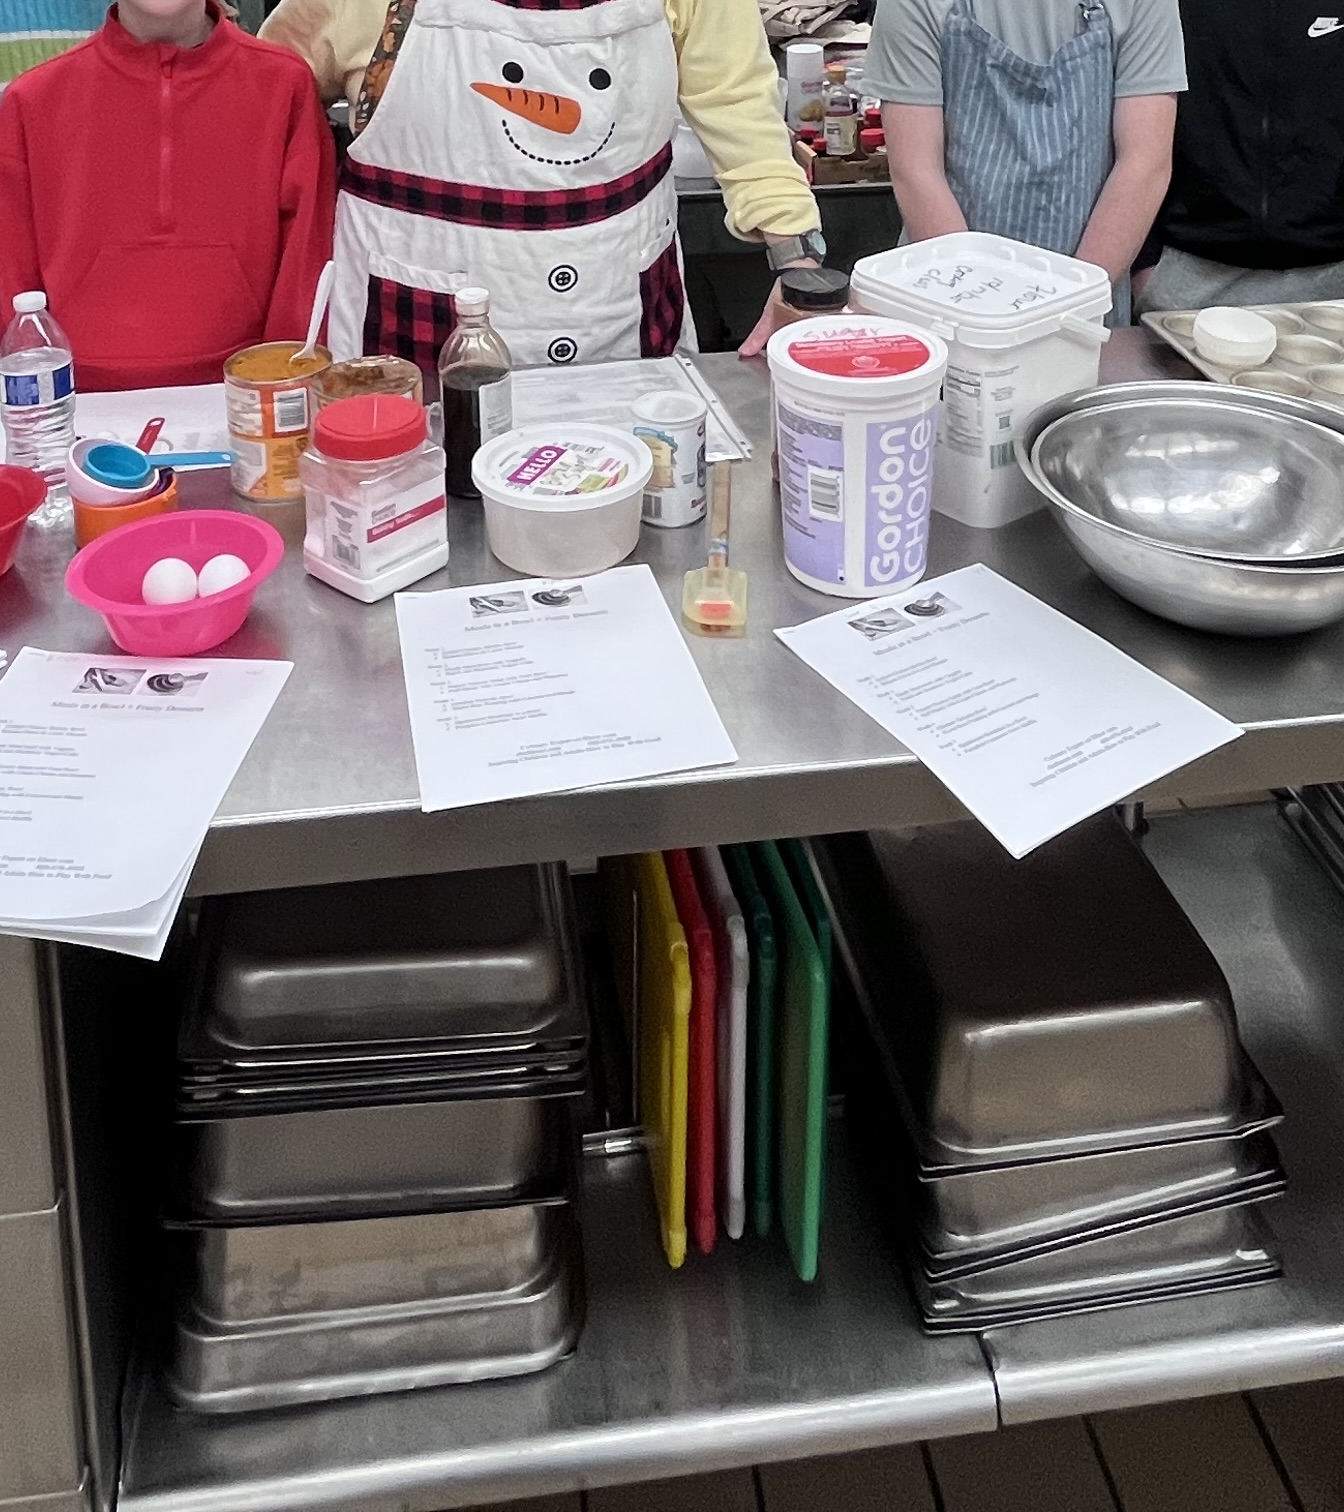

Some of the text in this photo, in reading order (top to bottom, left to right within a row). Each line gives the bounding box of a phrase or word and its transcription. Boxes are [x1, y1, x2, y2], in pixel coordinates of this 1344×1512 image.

[517, 449, 558, 481] HELLO
[870, 427, 906, 582] Gordon
[904, 418, 932, 573] CHOICE
